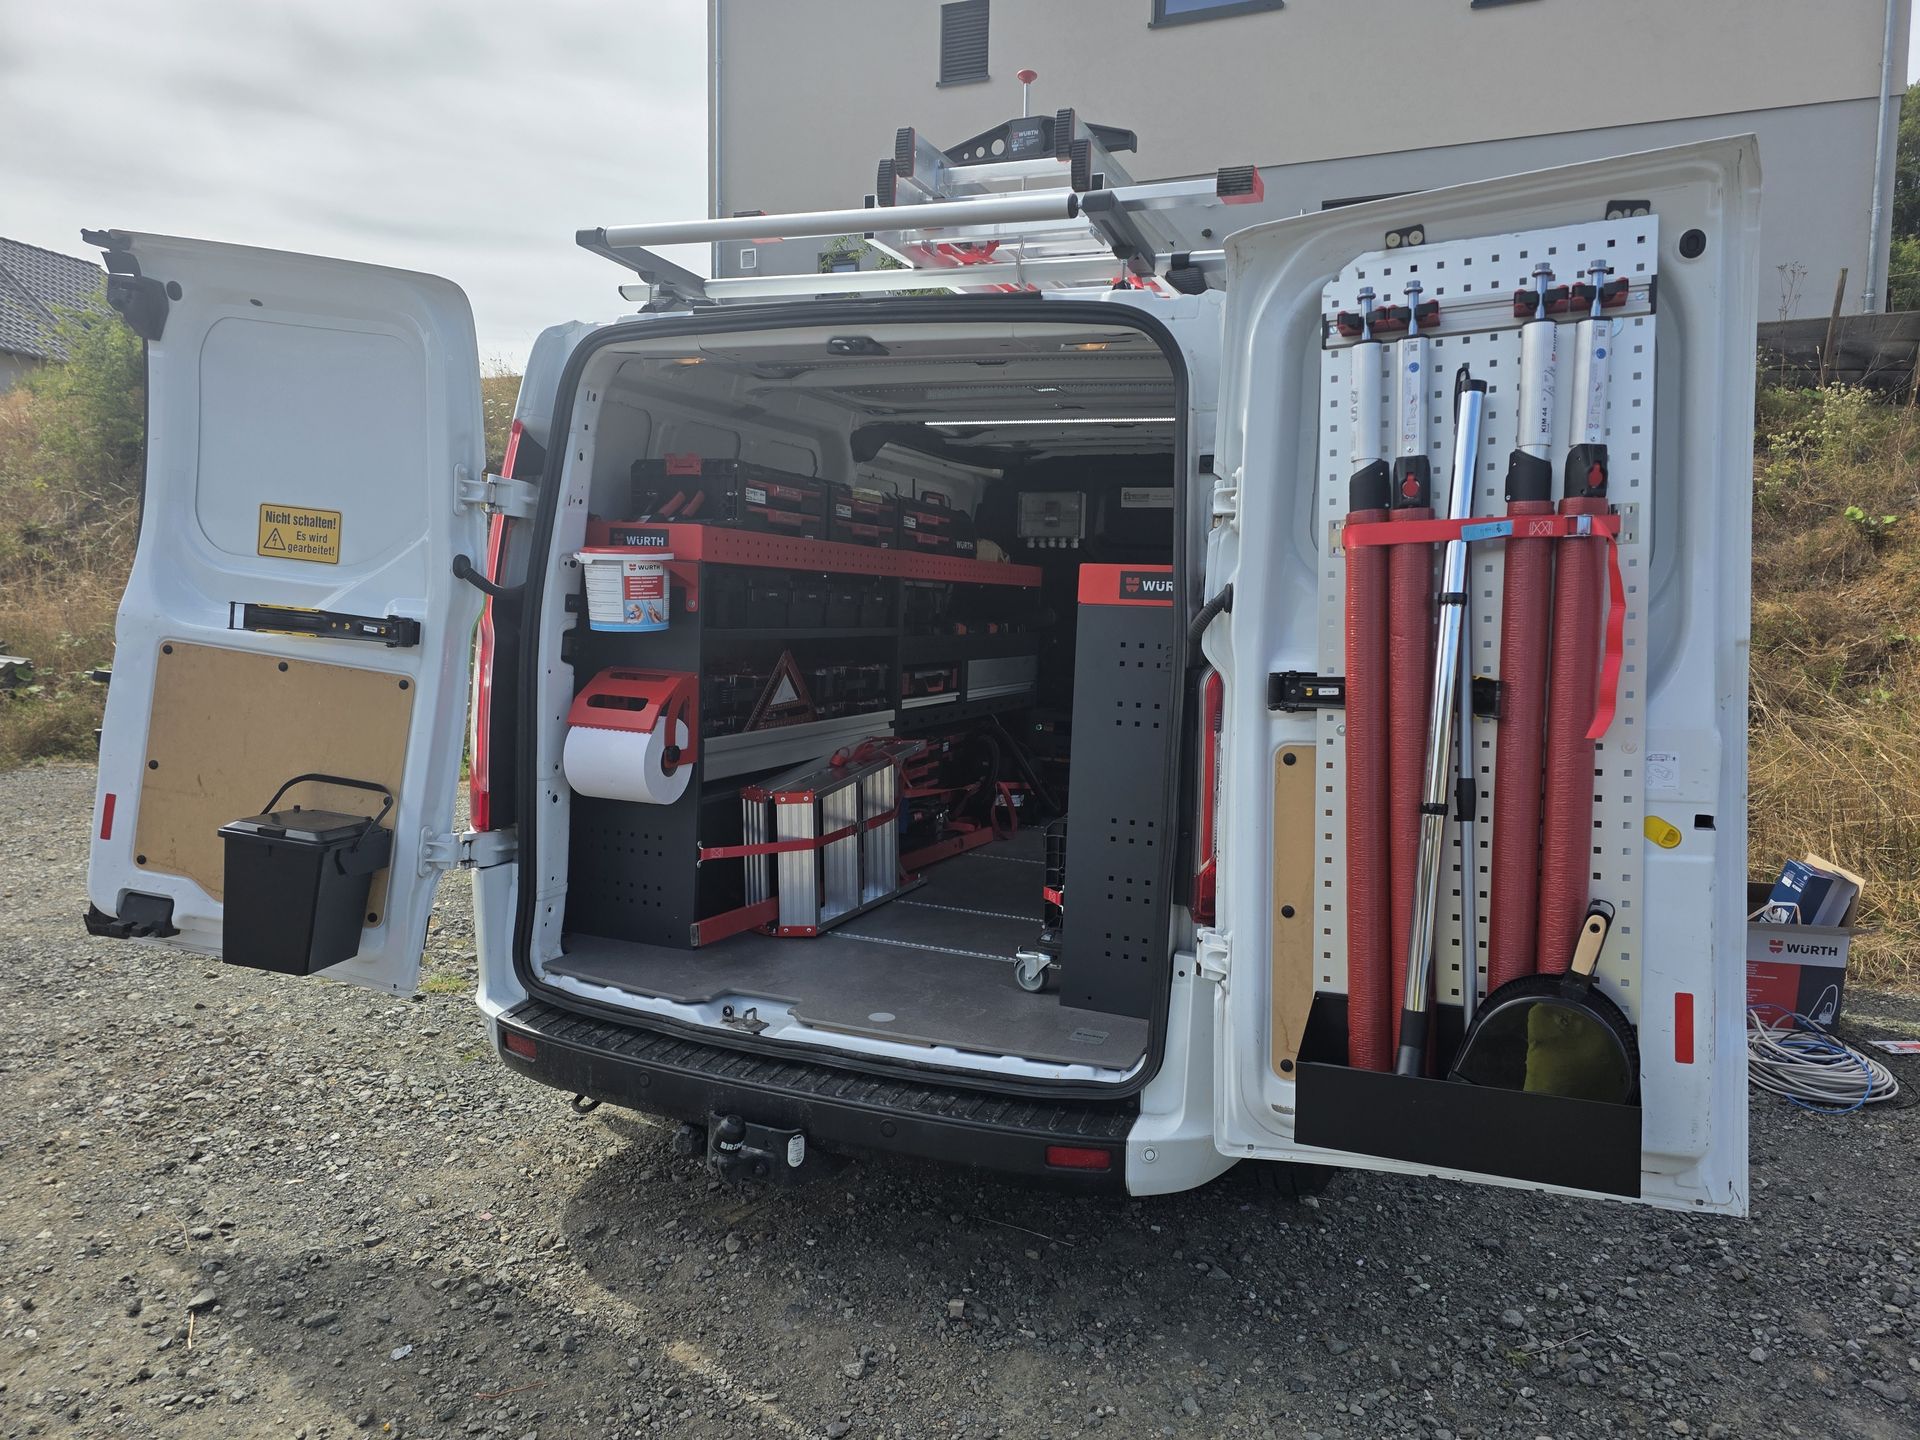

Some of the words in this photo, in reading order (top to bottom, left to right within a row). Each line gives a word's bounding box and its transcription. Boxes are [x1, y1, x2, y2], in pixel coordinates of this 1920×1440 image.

[1541, 407, 1547, 417] 44
[265, 510, 290, 525] Nicht
[293, 515, 337, 530] schalten!
[296, 531, 306, 541] Es
[309, 533, 328, 543] wird
[626, 535, 664, 546] WÜRTH
[287, 544, 335, 556] gearbeitet!
[638, 563, 661, 571] WÜRTH
[1786, 943, 1838, 956] WÜRTH
